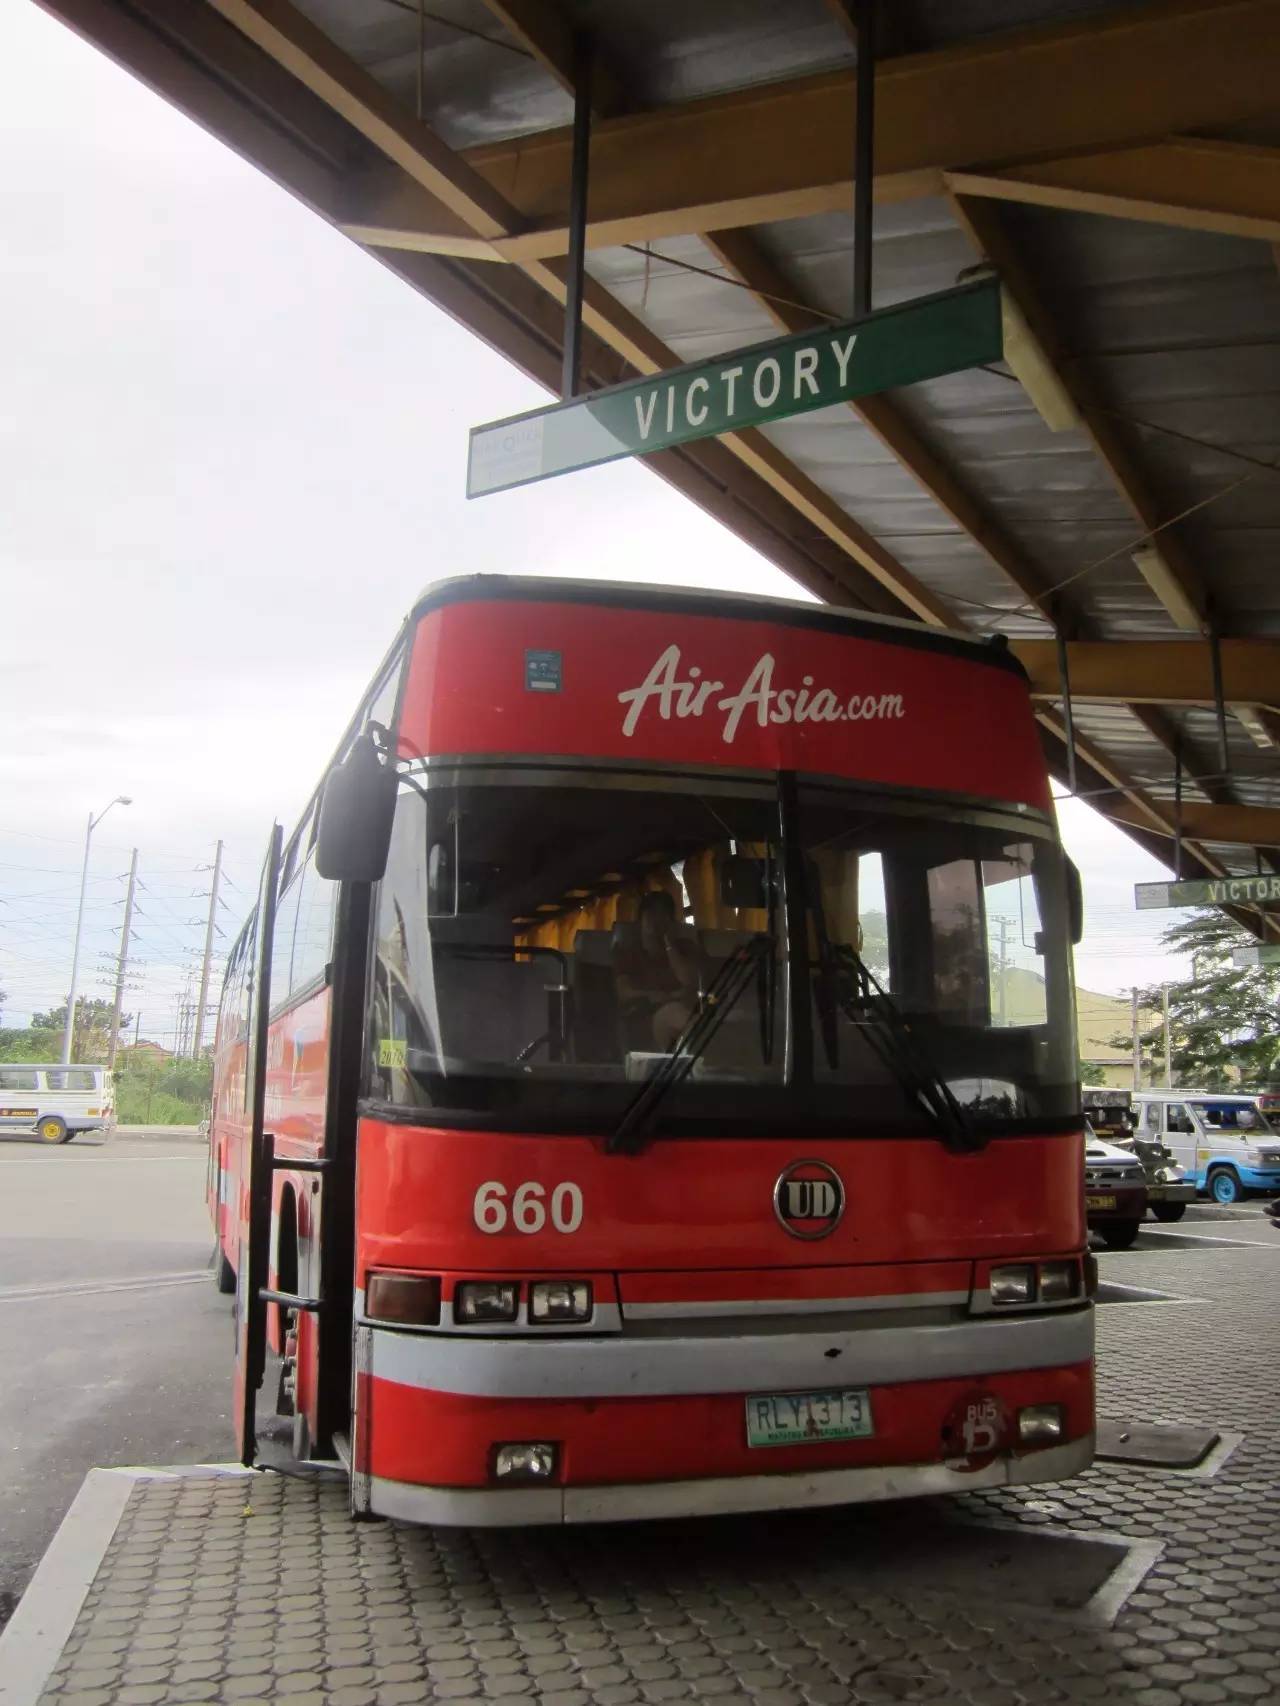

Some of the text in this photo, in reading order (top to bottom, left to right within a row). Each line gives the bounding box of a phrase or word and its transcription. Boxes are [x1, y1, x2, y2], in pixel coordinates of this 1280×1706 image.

[634, 335, 857, 440] VICTORY
[473, 1181, 584, 1234] 660
[786, 1181, 837, 1218] UD
[967, 1402, 997, 1422] BUS
